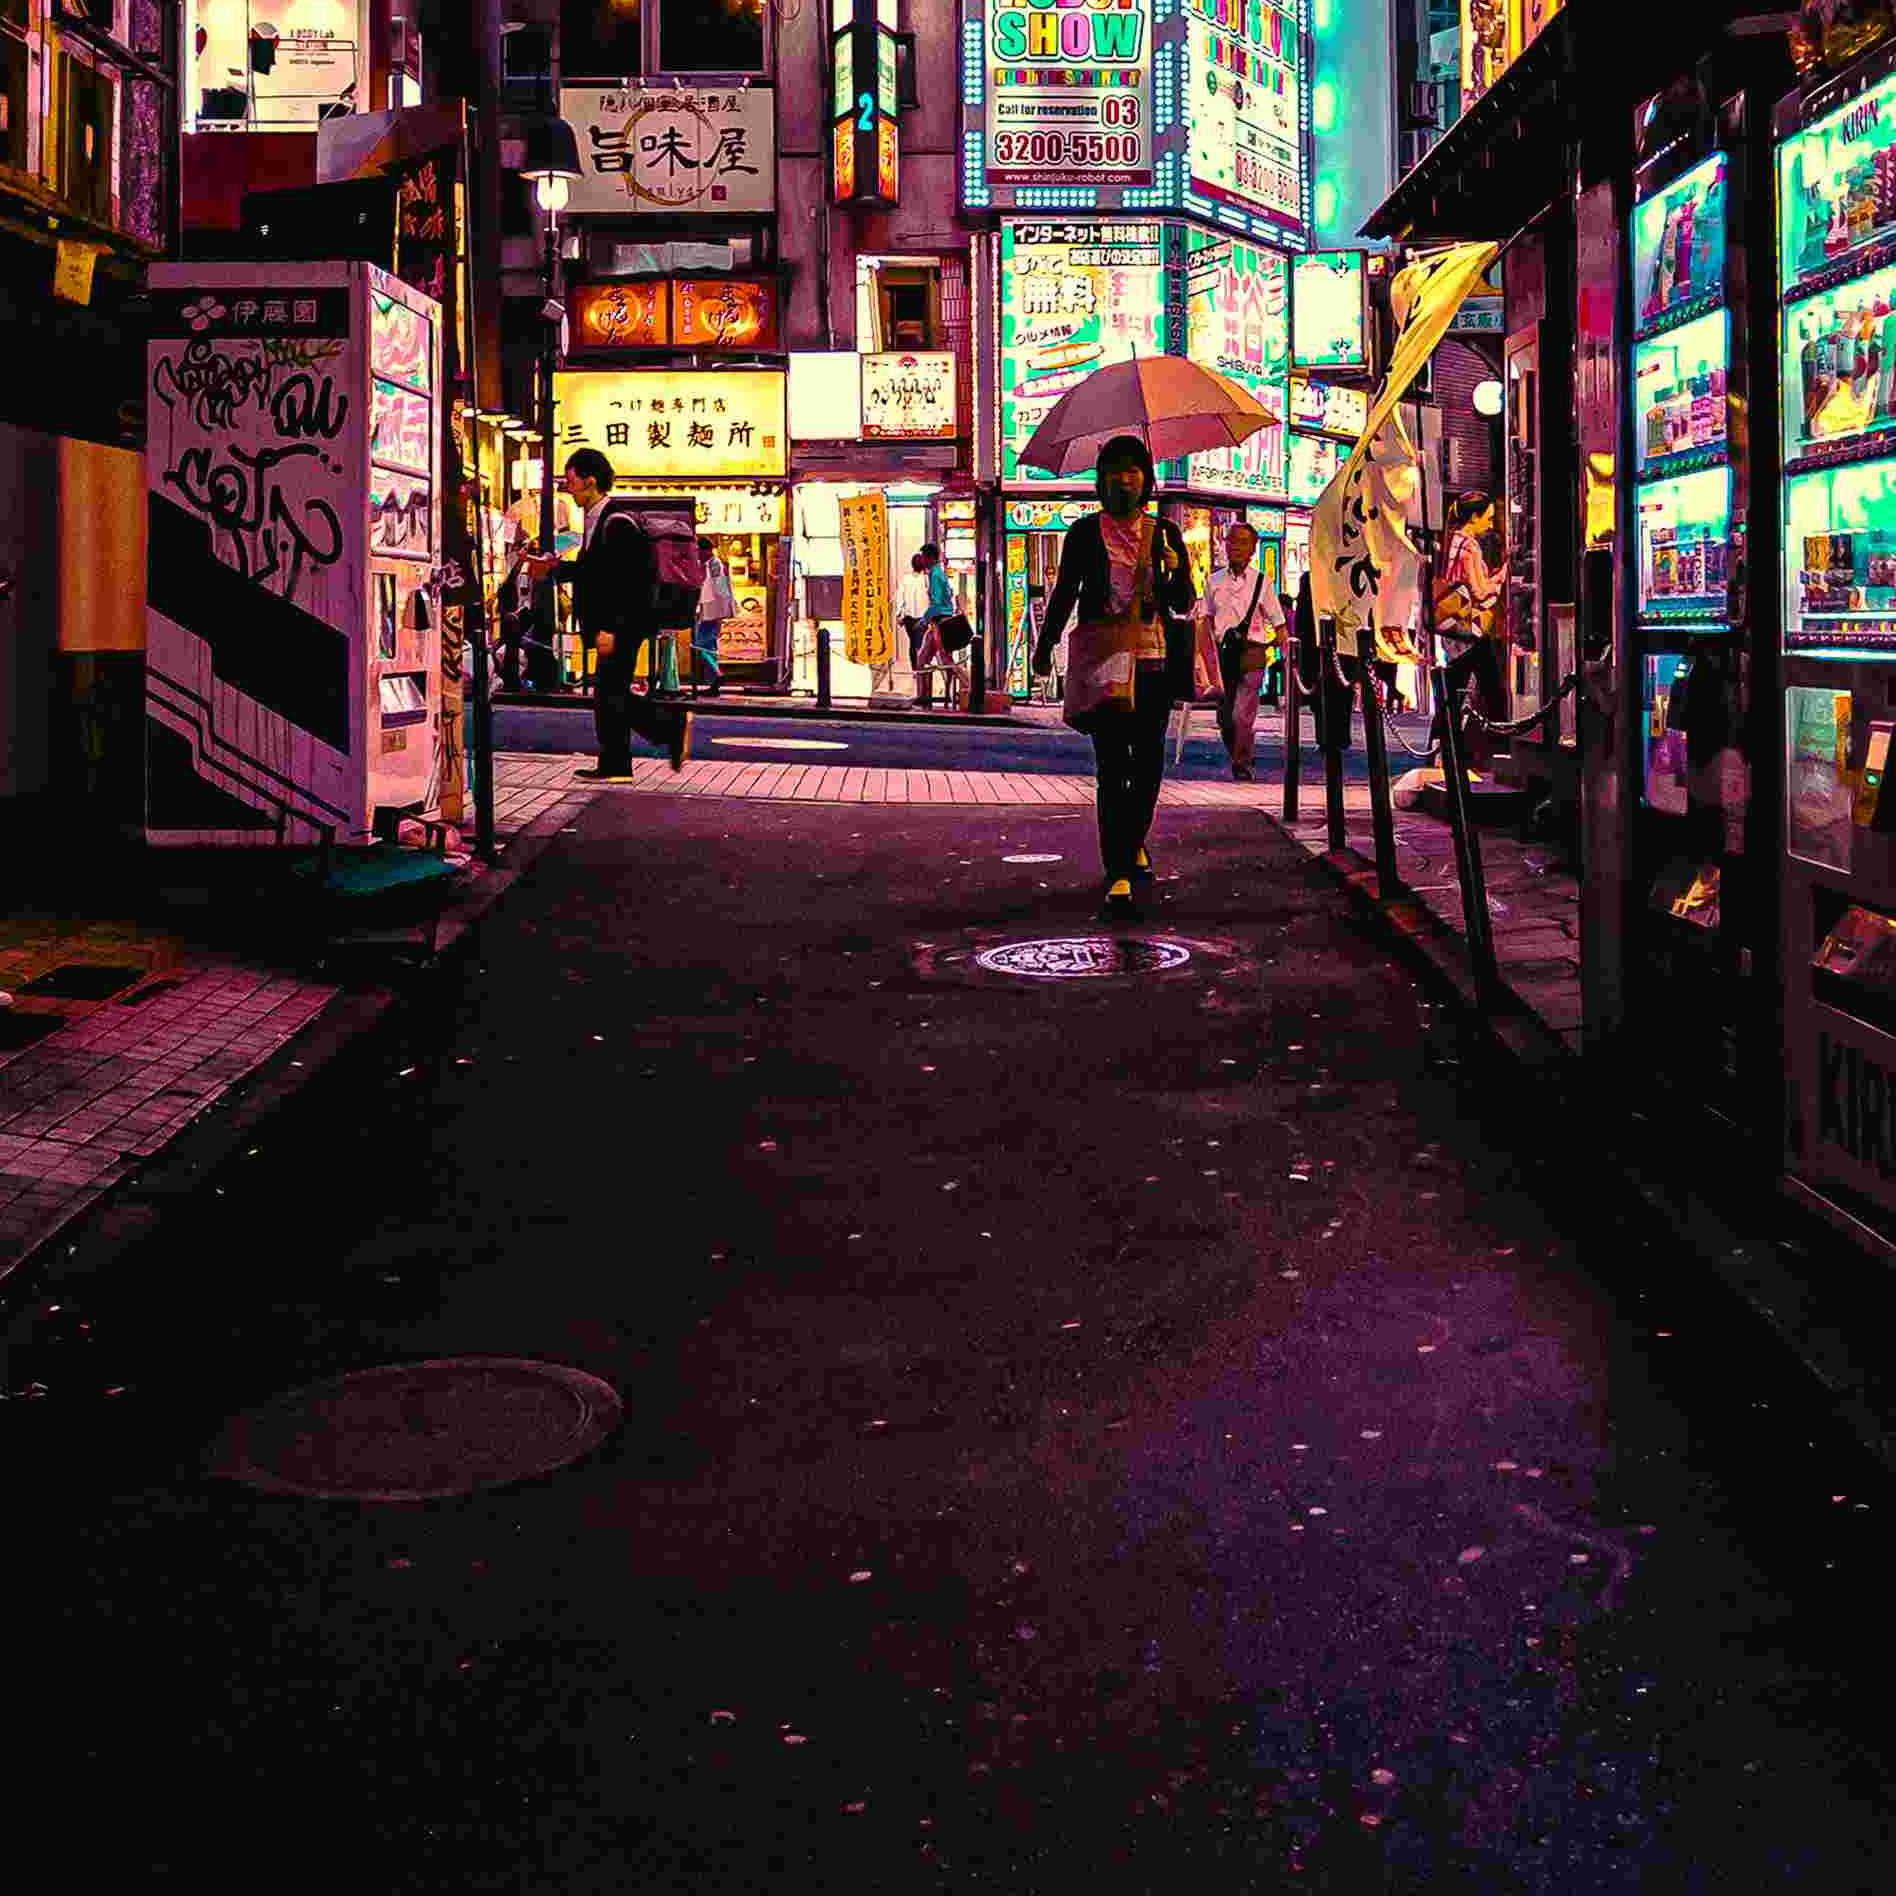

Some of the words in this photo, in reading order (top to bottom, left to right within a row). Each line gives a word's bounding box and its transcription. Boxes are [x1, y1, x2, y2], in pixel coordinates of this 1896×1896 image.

[996, 12, 1140, 59] SHOW
[857, 91, 873, 132] 2
[1103, 98, 1139, 126] 03
[1842, 98, 1881, 146] KIRIN
[588, 124, 760, 177] 旨味屋
[997, 134, 1139, 163] 3200-5500
[232, 298, 317, 325] 伊藤園
[1215, 354, 1264, 377] SHIBUYA
[609, 397, 729, 413] つけ麺専門店
[562, 420, 756, 449] 三田製麺所
